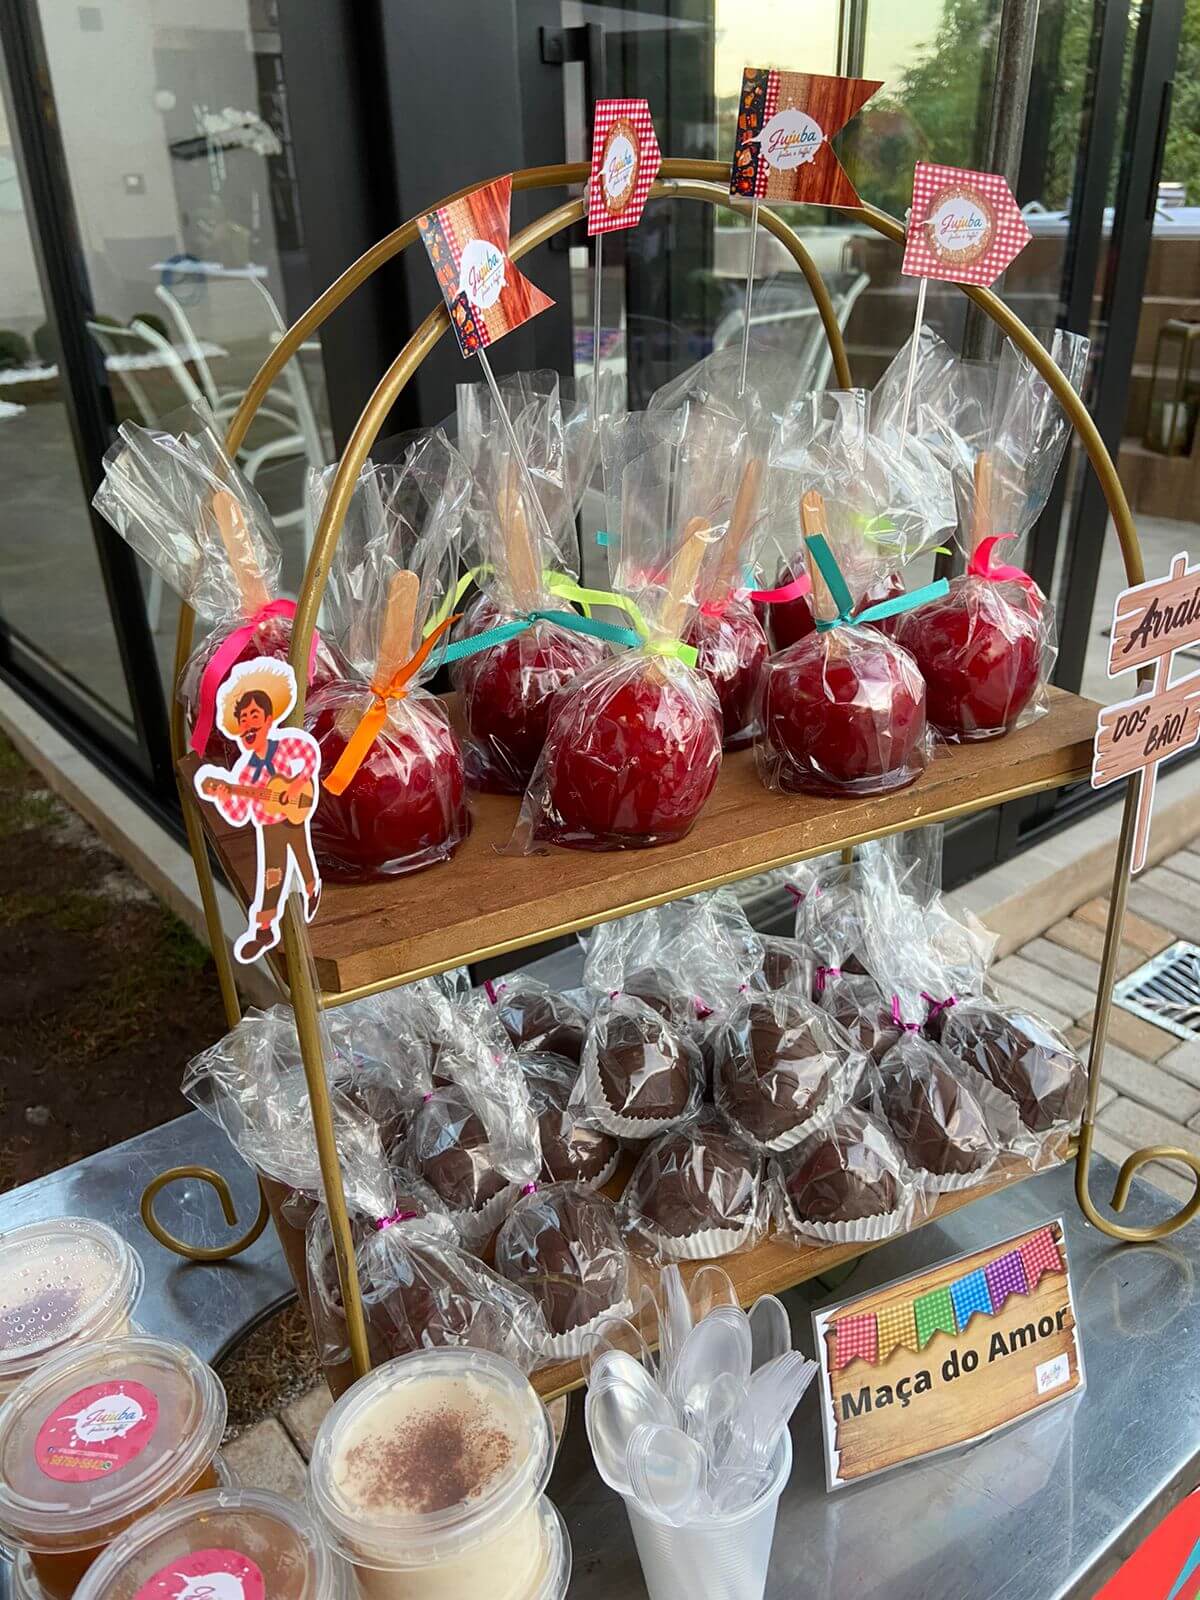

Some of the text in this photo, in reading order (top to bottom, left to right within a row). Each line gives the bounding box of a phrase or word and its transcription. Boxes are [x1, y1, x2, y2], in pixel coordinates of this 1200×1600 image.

[768, 125, 817, 153] Jujuba
[940, 213, 983, 235] Jujuba
[1112, 705, 1151, 743] DOS
[1143, 707, 1189, 757] BÃO!
[841, 1368, 932, 1421] Maça
[941, 1349, 979, 1382] do
[987, 1307, 1068, 1363] Amor
